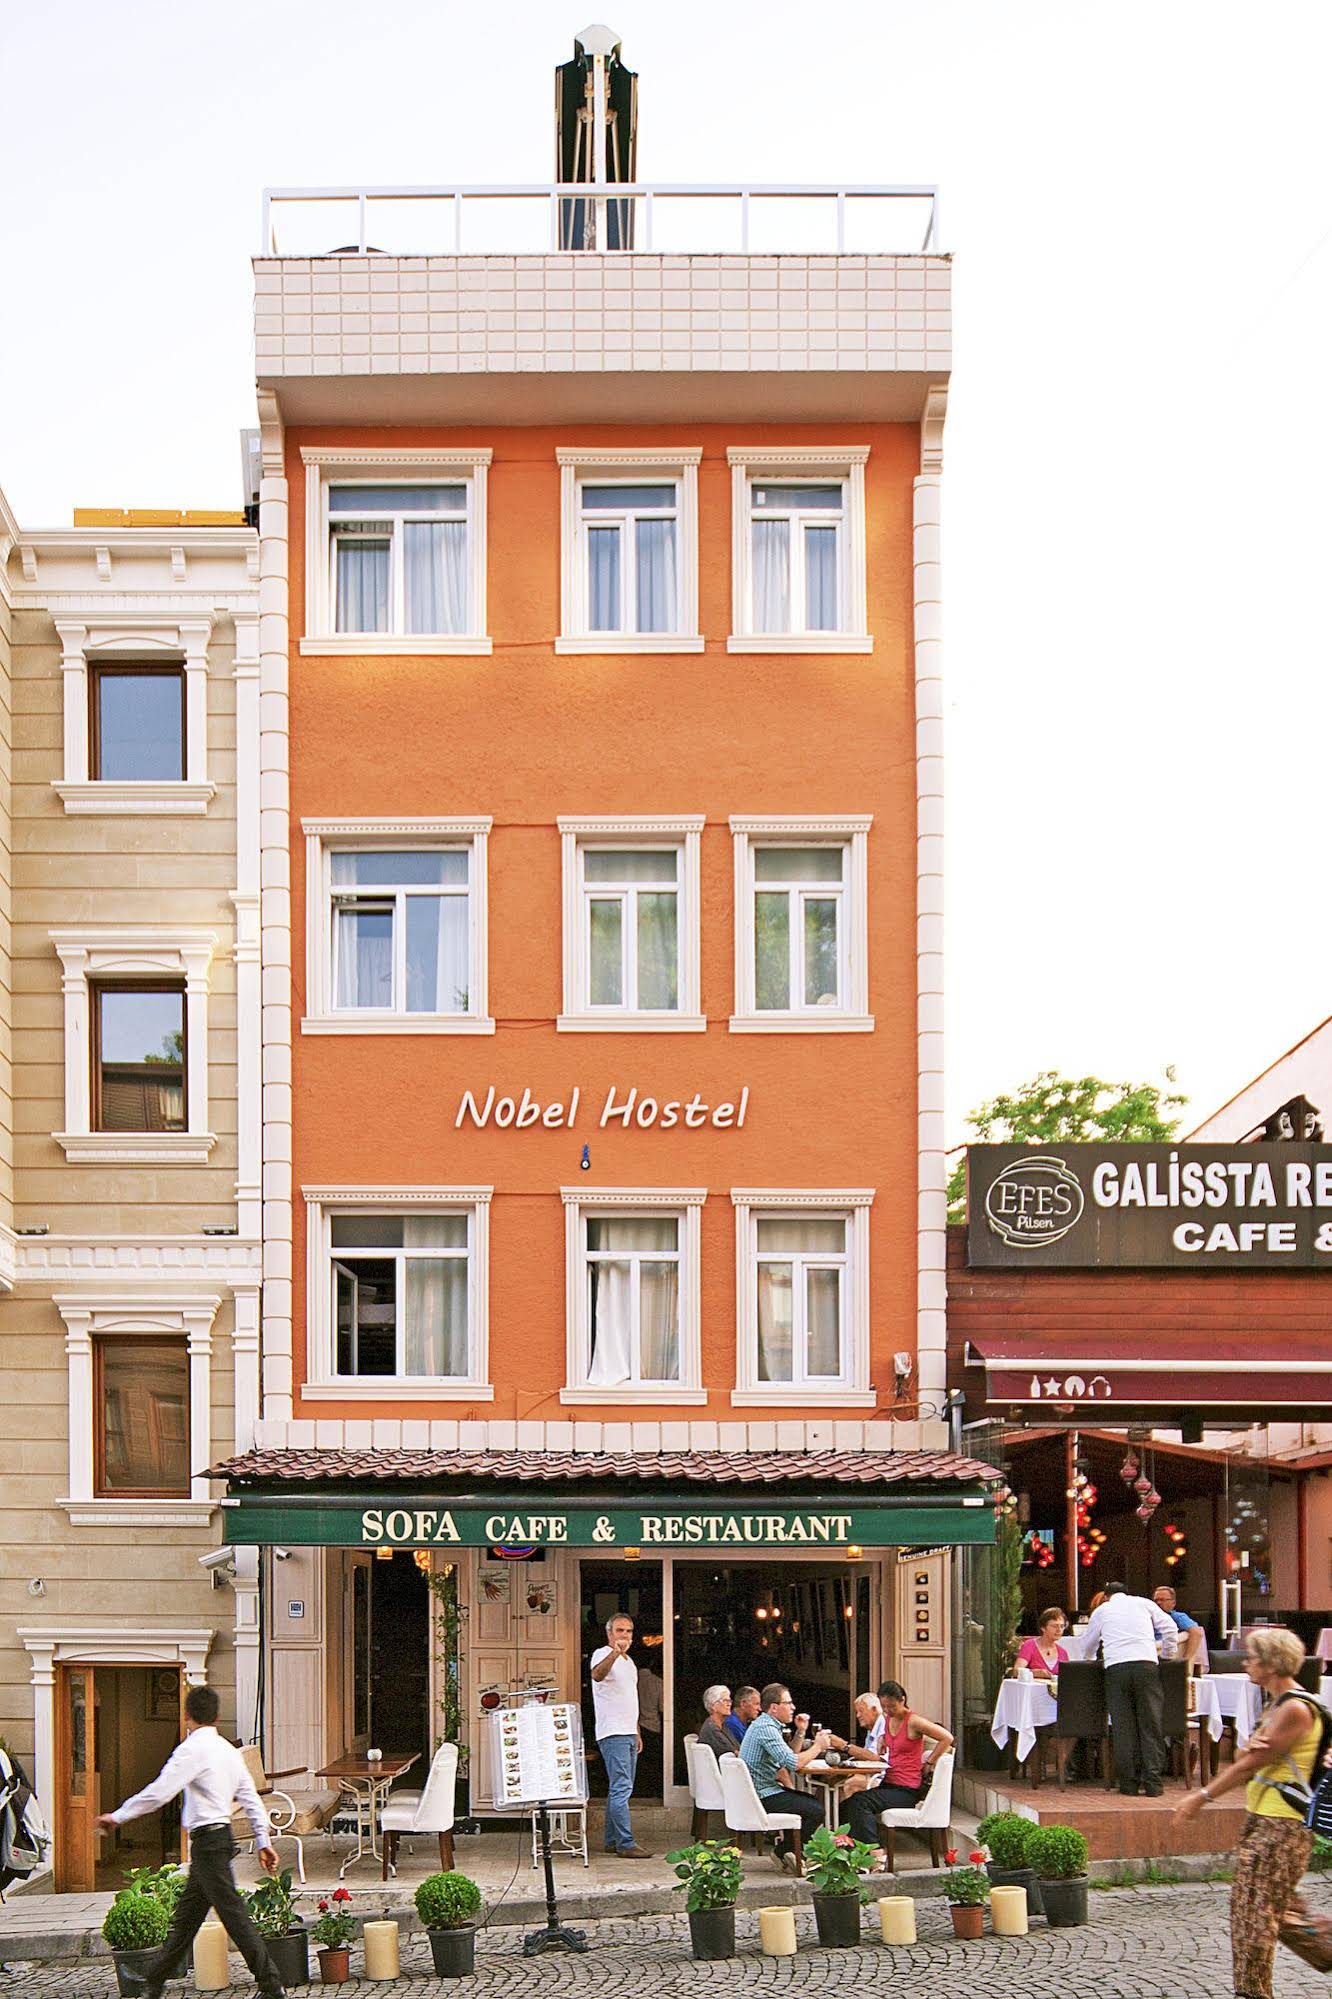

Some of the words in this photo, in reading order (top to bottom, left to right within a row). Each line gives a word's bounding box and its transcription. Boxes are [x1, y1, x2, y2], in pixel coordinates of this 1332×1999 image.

[455, 1086, 580, 1127] Nobel
[600, 1086, 749, 1127] Hostel
[1092, 1151, 1277, 1207] GALİSSTA
[997, 1181, 1072, 1216] EFES
[1016, 1215, 1055, 1231] Pilsen
[1172, 1222, 1297, 1252] CAFE
[362, 1510, 461, 1541] SOFA
[485, 1516, 568, 1541] CAFE
[592, 1516, 616, 1541] &
[640, 1515, 852, 1542] RESTAURANT
